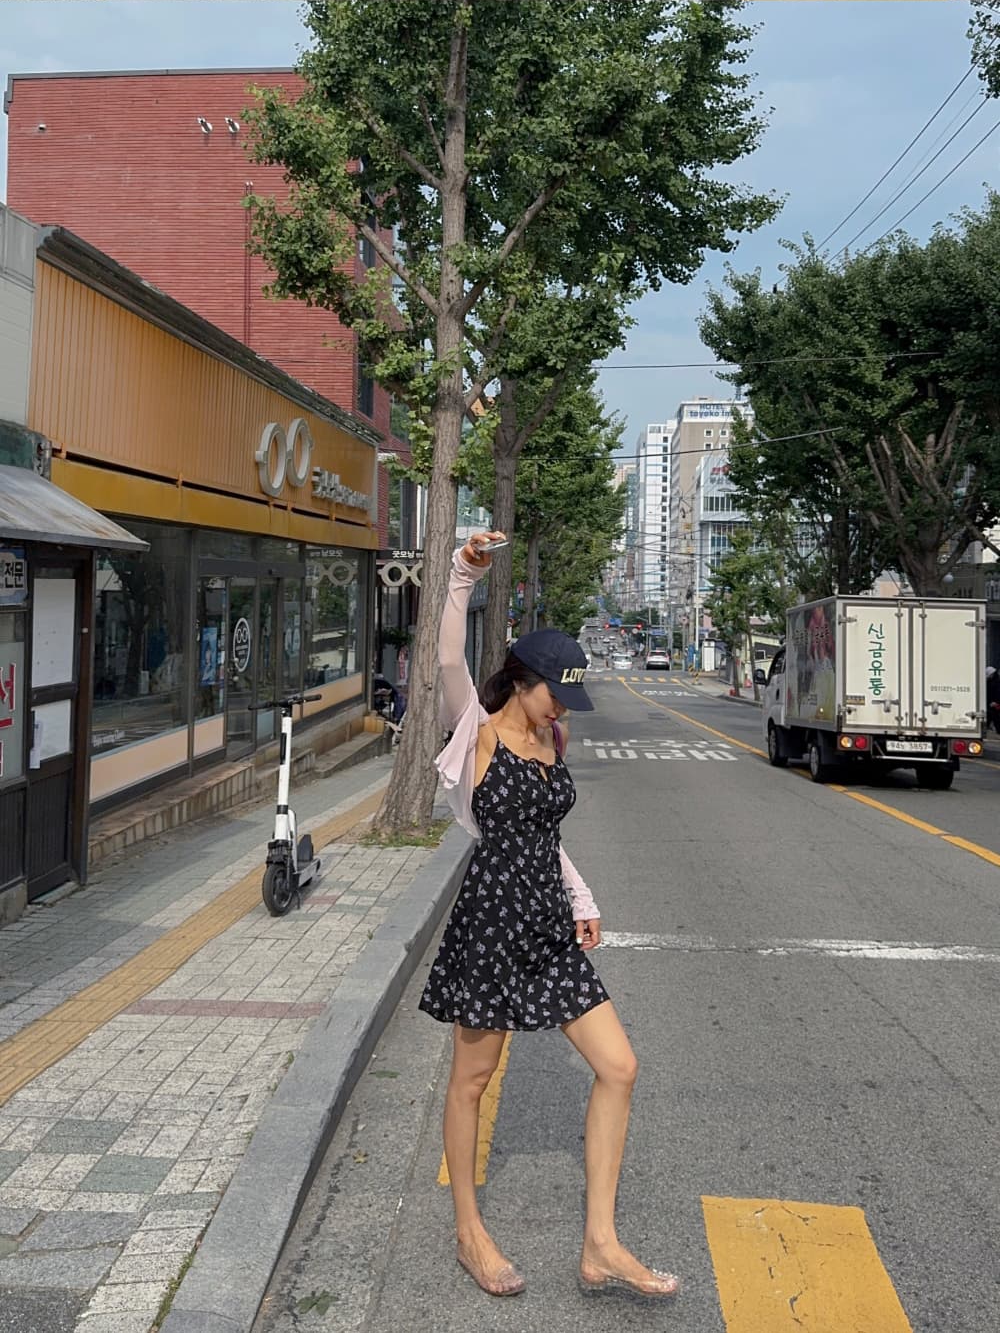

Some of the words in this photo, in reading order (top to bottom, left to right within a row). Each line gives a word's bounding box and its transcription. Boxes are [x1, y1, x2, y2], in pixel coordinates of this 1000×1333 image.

[689, 410, 720, 418] toyoko
[392, 550, 415, 559] 굿모닝
[868, 623, 886, 696] 신금유통
[561, 668, 585, 684] LOV
[595, 748, 738, 761] 어린이
